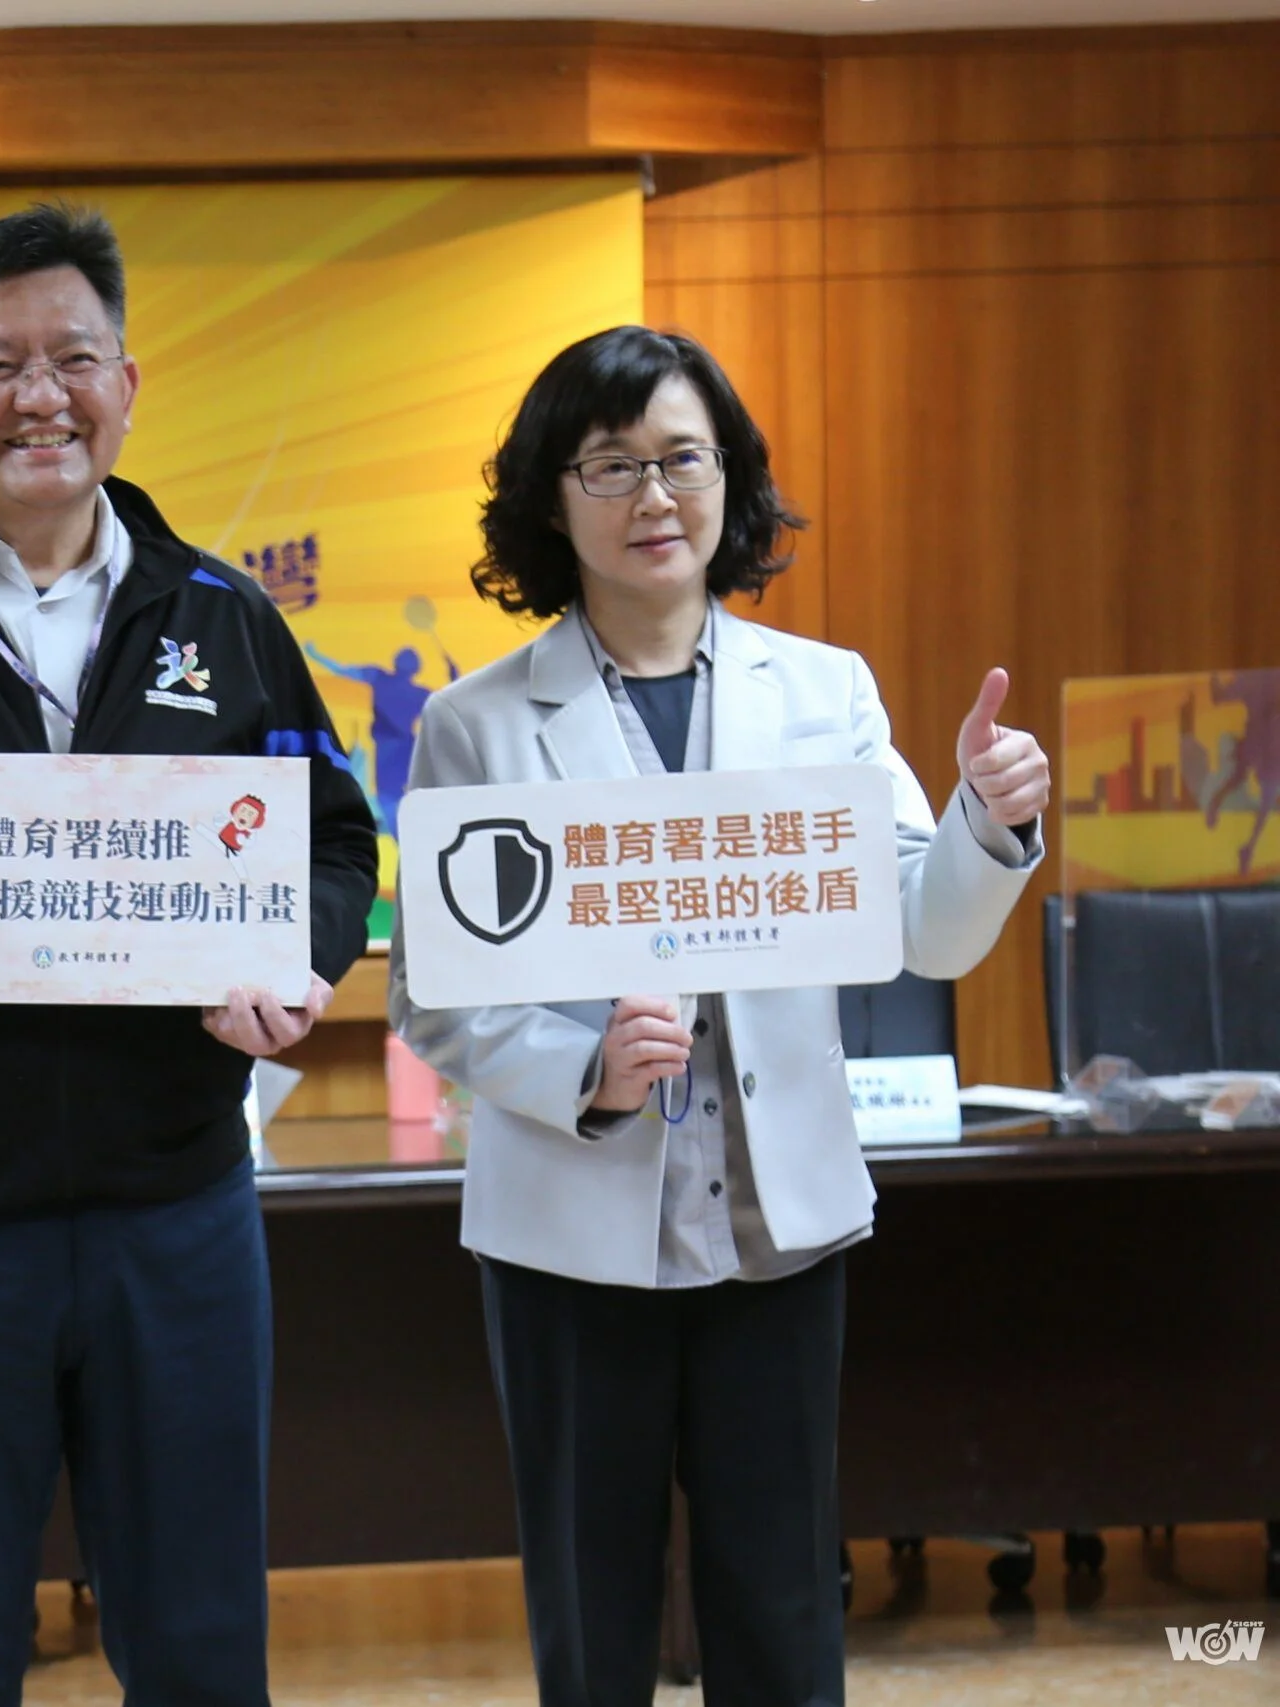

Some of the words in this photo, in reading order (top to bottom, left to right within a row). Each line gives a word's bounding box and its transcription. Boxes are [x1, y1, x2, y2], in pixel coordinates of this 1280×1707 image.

[563, 806, 858, 870] 體育署是選手
